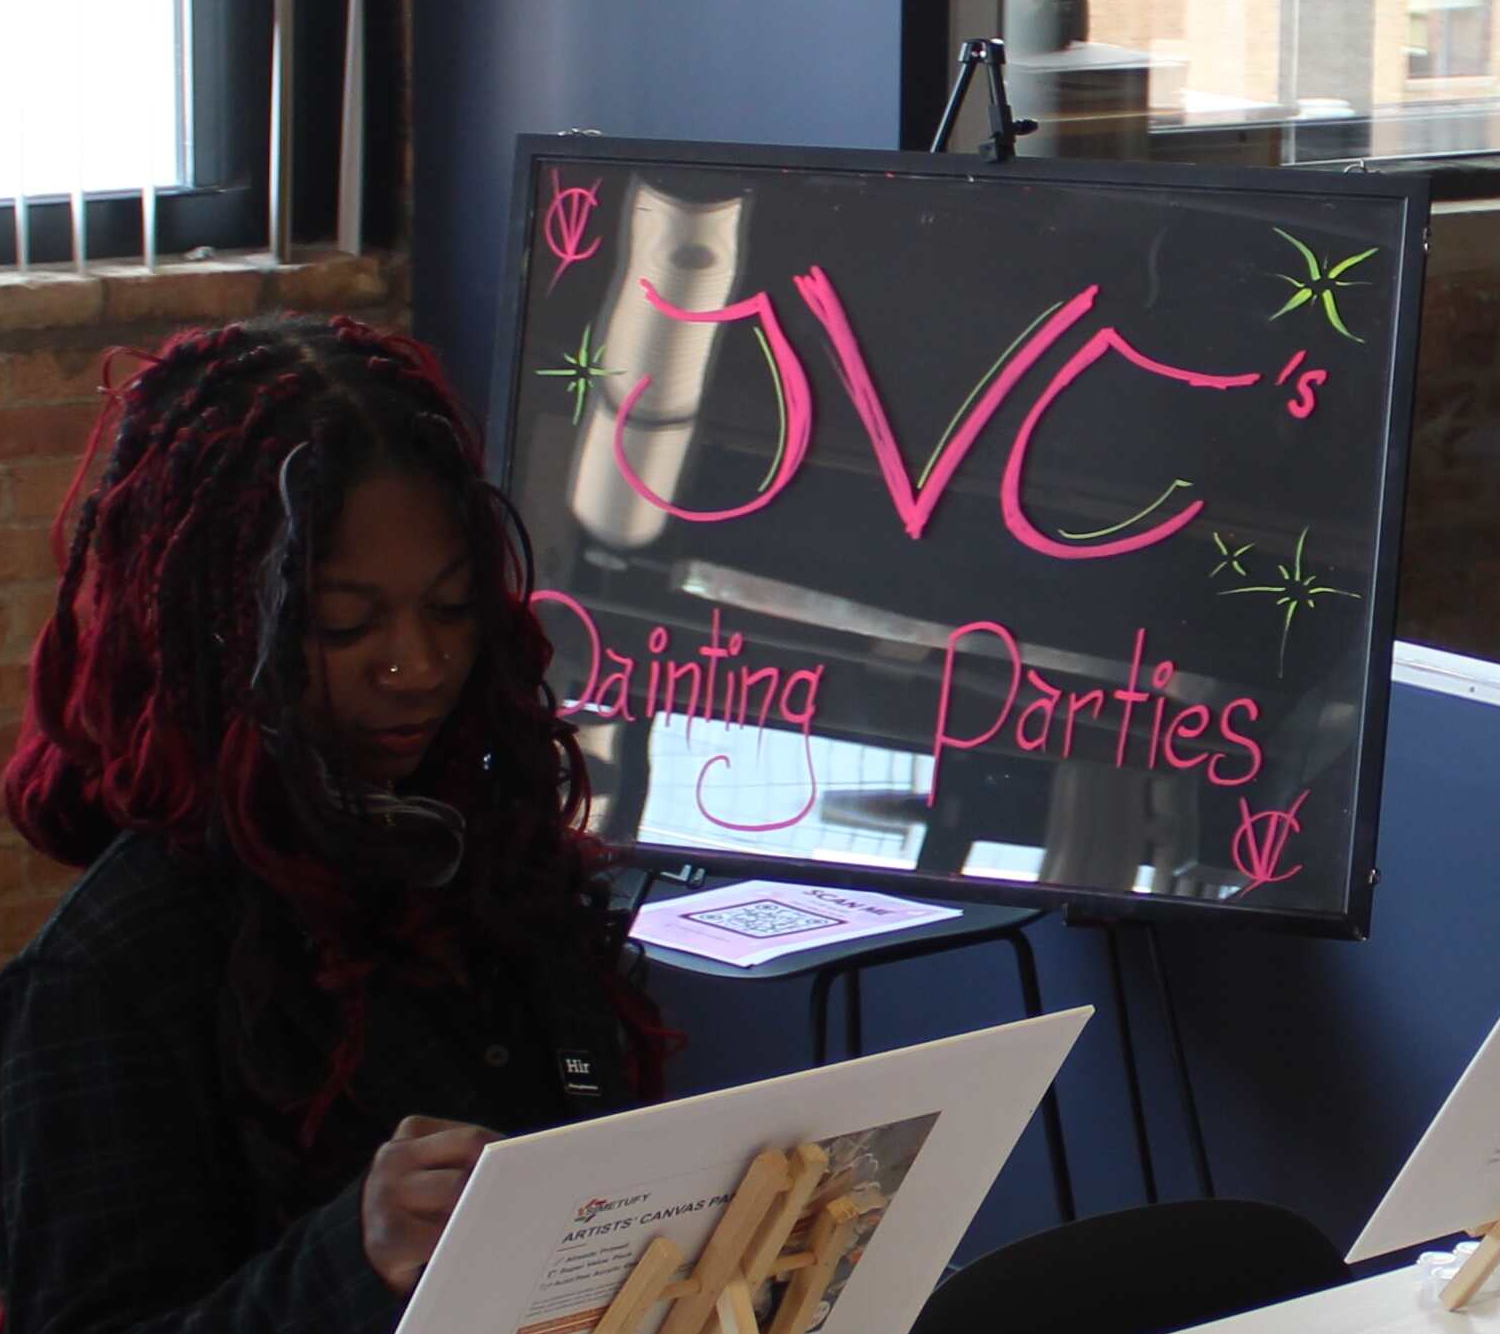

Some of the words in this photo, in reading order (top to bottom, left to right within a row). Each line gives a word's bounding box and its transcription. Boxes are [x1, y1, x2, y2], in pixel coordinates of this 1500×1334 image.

[927, 620, 1263, 808] Parties
[639, 1199, 705, 1224] CANVAS
[707, 1192, 736, 1208] PA
